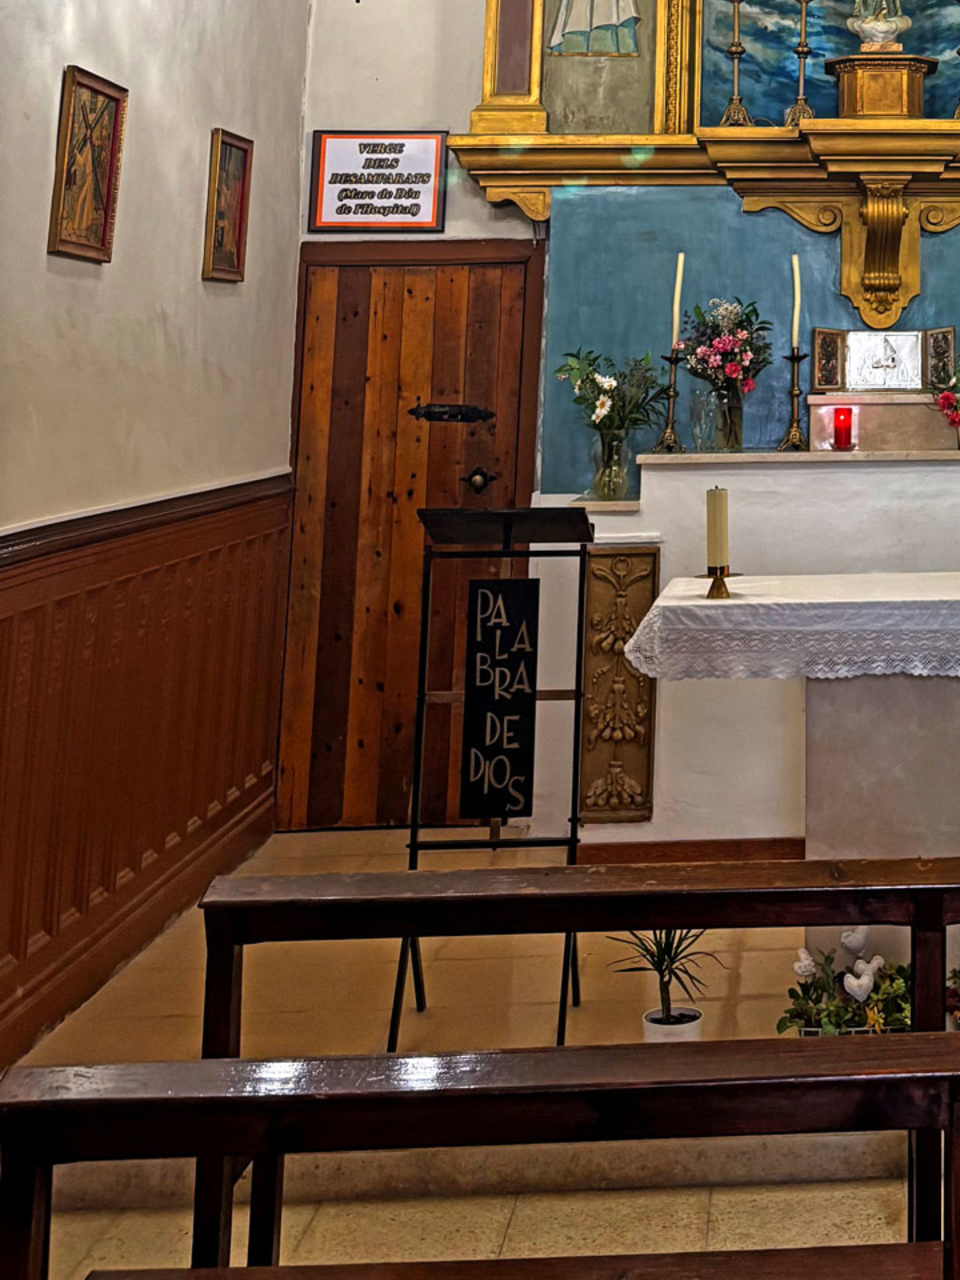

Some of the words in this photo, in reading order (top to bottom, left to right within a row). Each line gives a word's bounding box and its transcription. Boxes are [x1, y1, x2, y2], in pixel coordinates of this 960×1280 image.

[362, 157, 400, 169] DELS
[328, 172, 432, 184] DESAMPARATS
[377, 188, 393, 200] de
[335, 203, 352, 215] de
[485, 711, 521, 750] DE
[469, 747, 526, 812] DIOS
